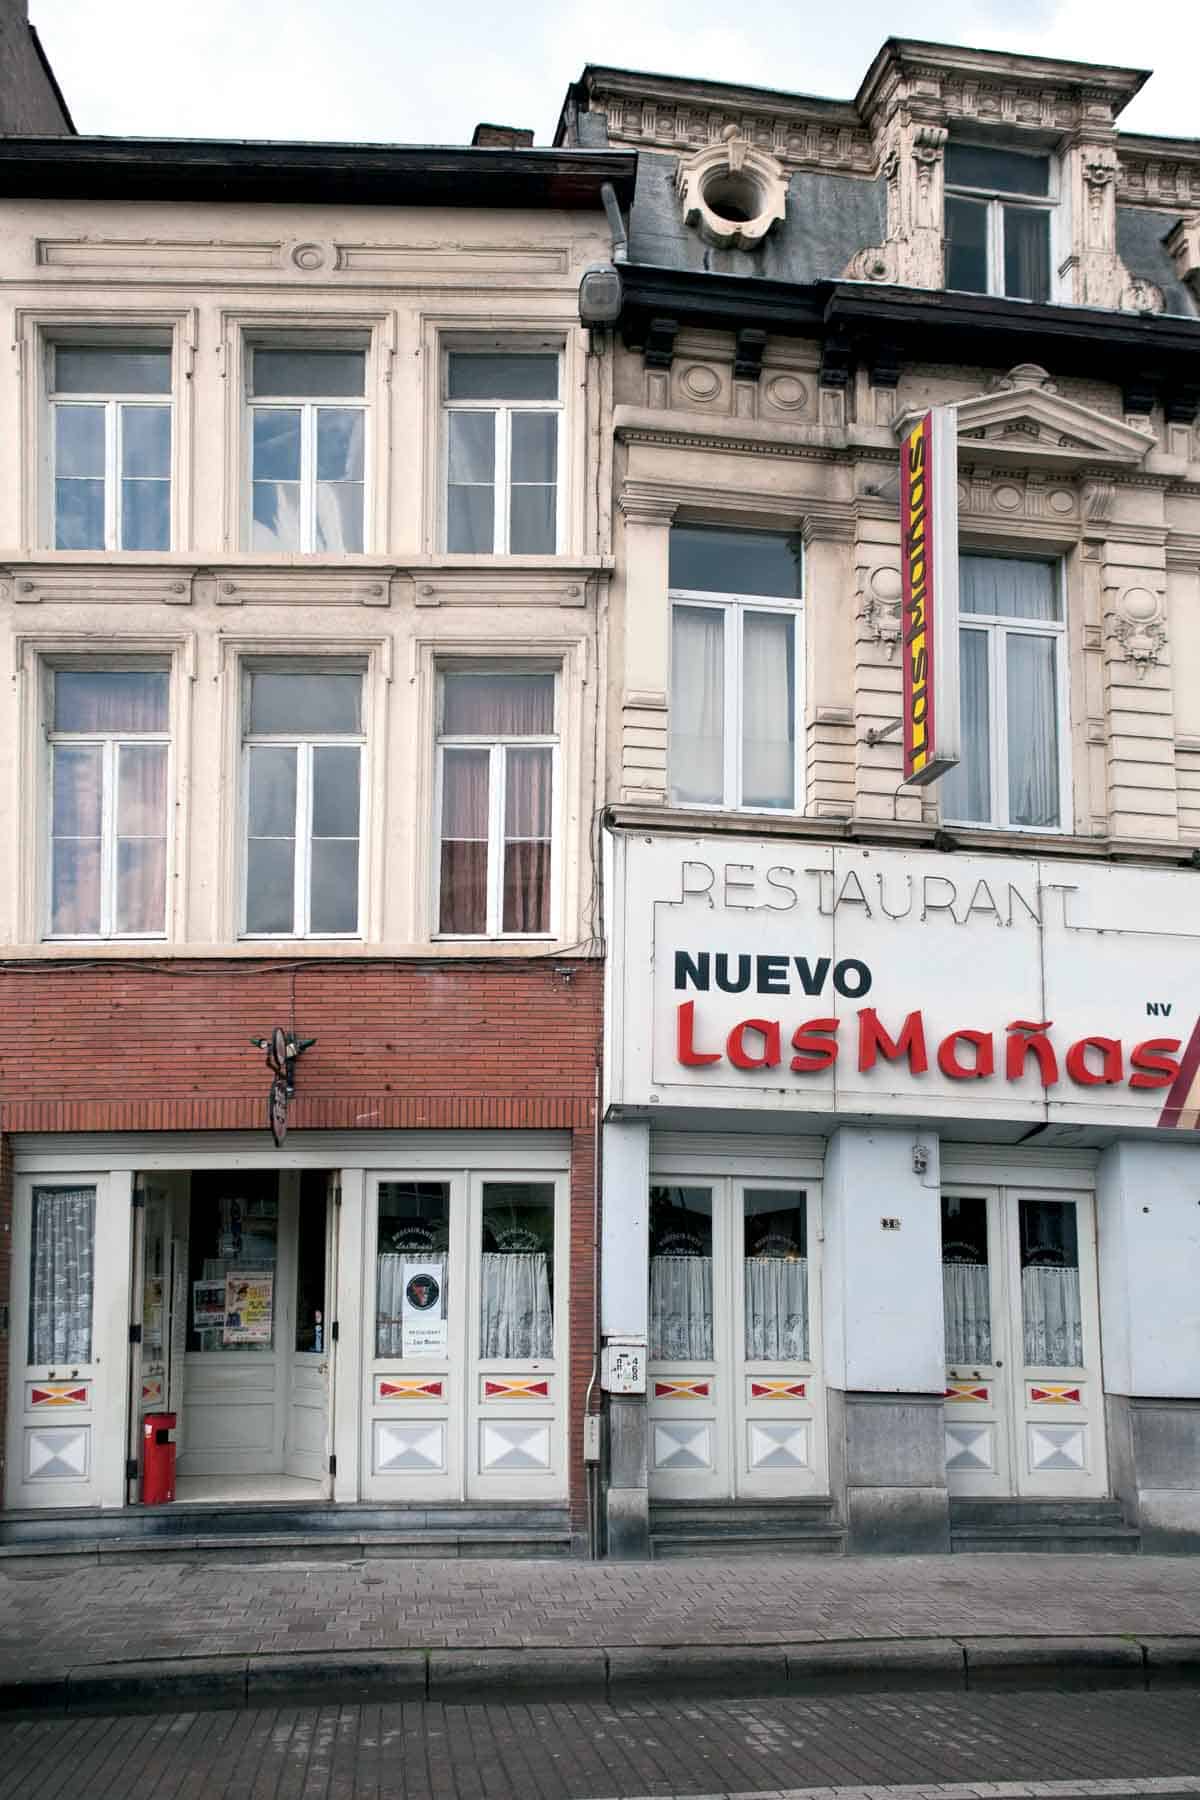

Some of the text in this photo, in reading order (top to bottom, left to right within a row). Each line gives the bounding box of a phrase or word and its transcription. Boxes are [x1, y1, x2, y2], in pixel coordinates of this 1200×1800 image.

[904, 435, 929, 761] Las Mañas
[681, 860, 1080, 929] RESTAURANT
[673, 950, 873, 999] NUEVO
[1146, 1002, 1172, 1017] NV
[676, 999, 1183, 1090] Las Mañas
